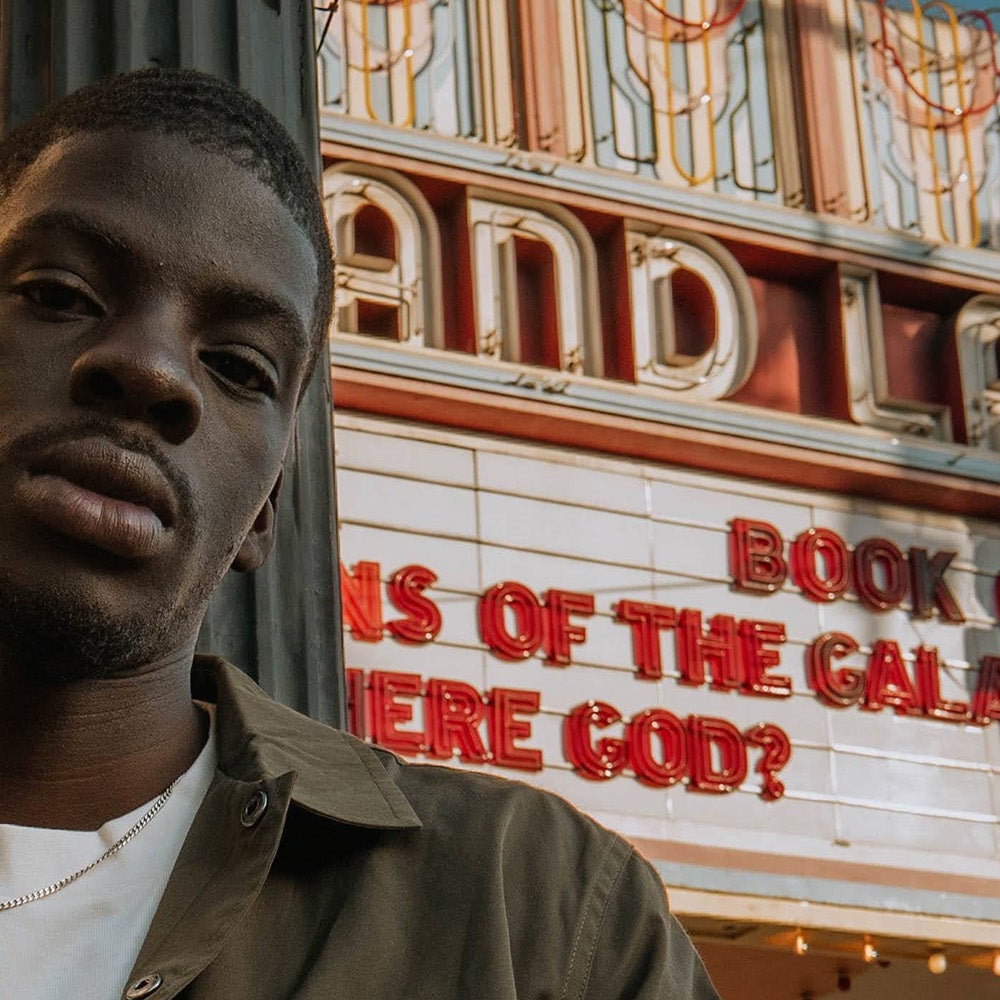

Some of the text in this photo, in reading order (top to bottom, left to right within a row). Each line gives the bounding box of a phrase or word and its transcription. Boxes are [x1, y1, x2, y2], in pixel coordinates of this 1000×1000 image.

[727, 516, 967, 625] BOOK
[478, 581, 596, 667] OF
[614, 599, 793, 697] THE
[562, 698, 794, 802] GOD?
